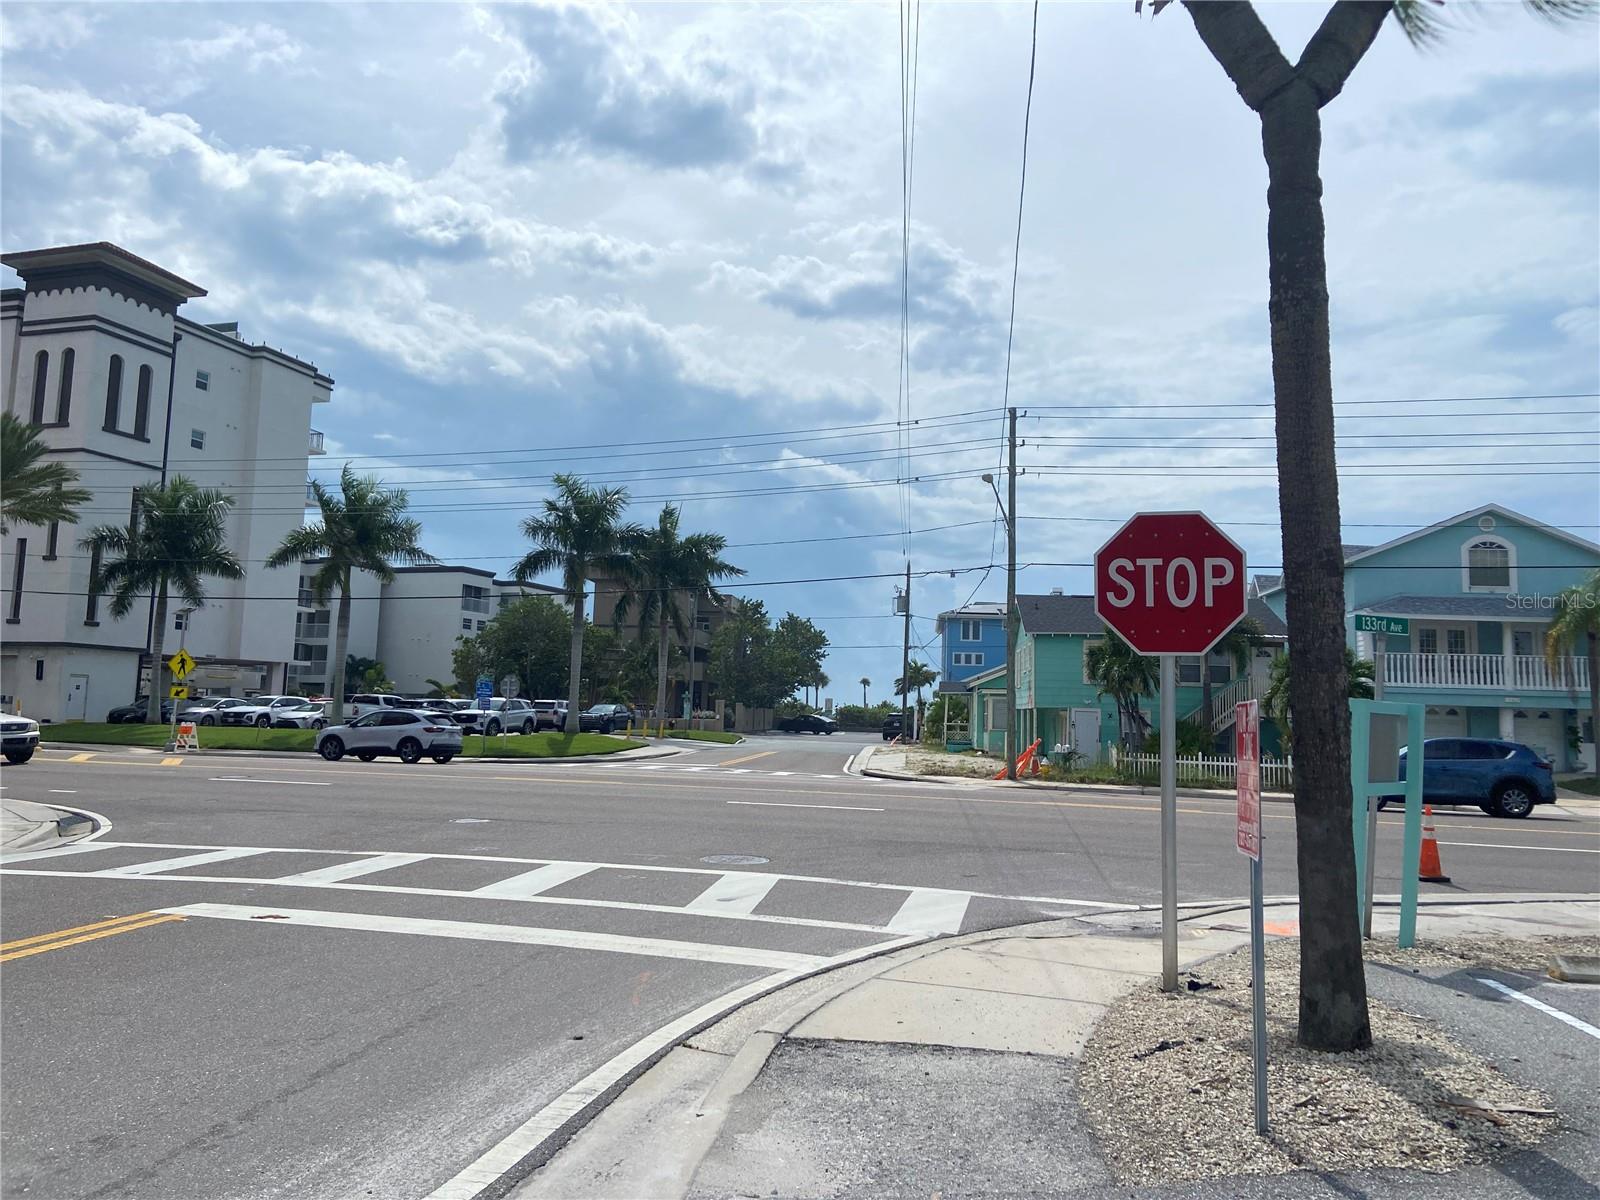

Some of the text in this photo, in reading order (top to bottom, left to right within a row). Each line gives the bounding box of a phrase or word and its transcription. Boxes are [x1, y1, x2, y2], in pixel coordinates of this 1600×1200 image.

[1106, 557, 1235, 608] STOP
[1362, 616, 1403, 633] 133rd Ave
